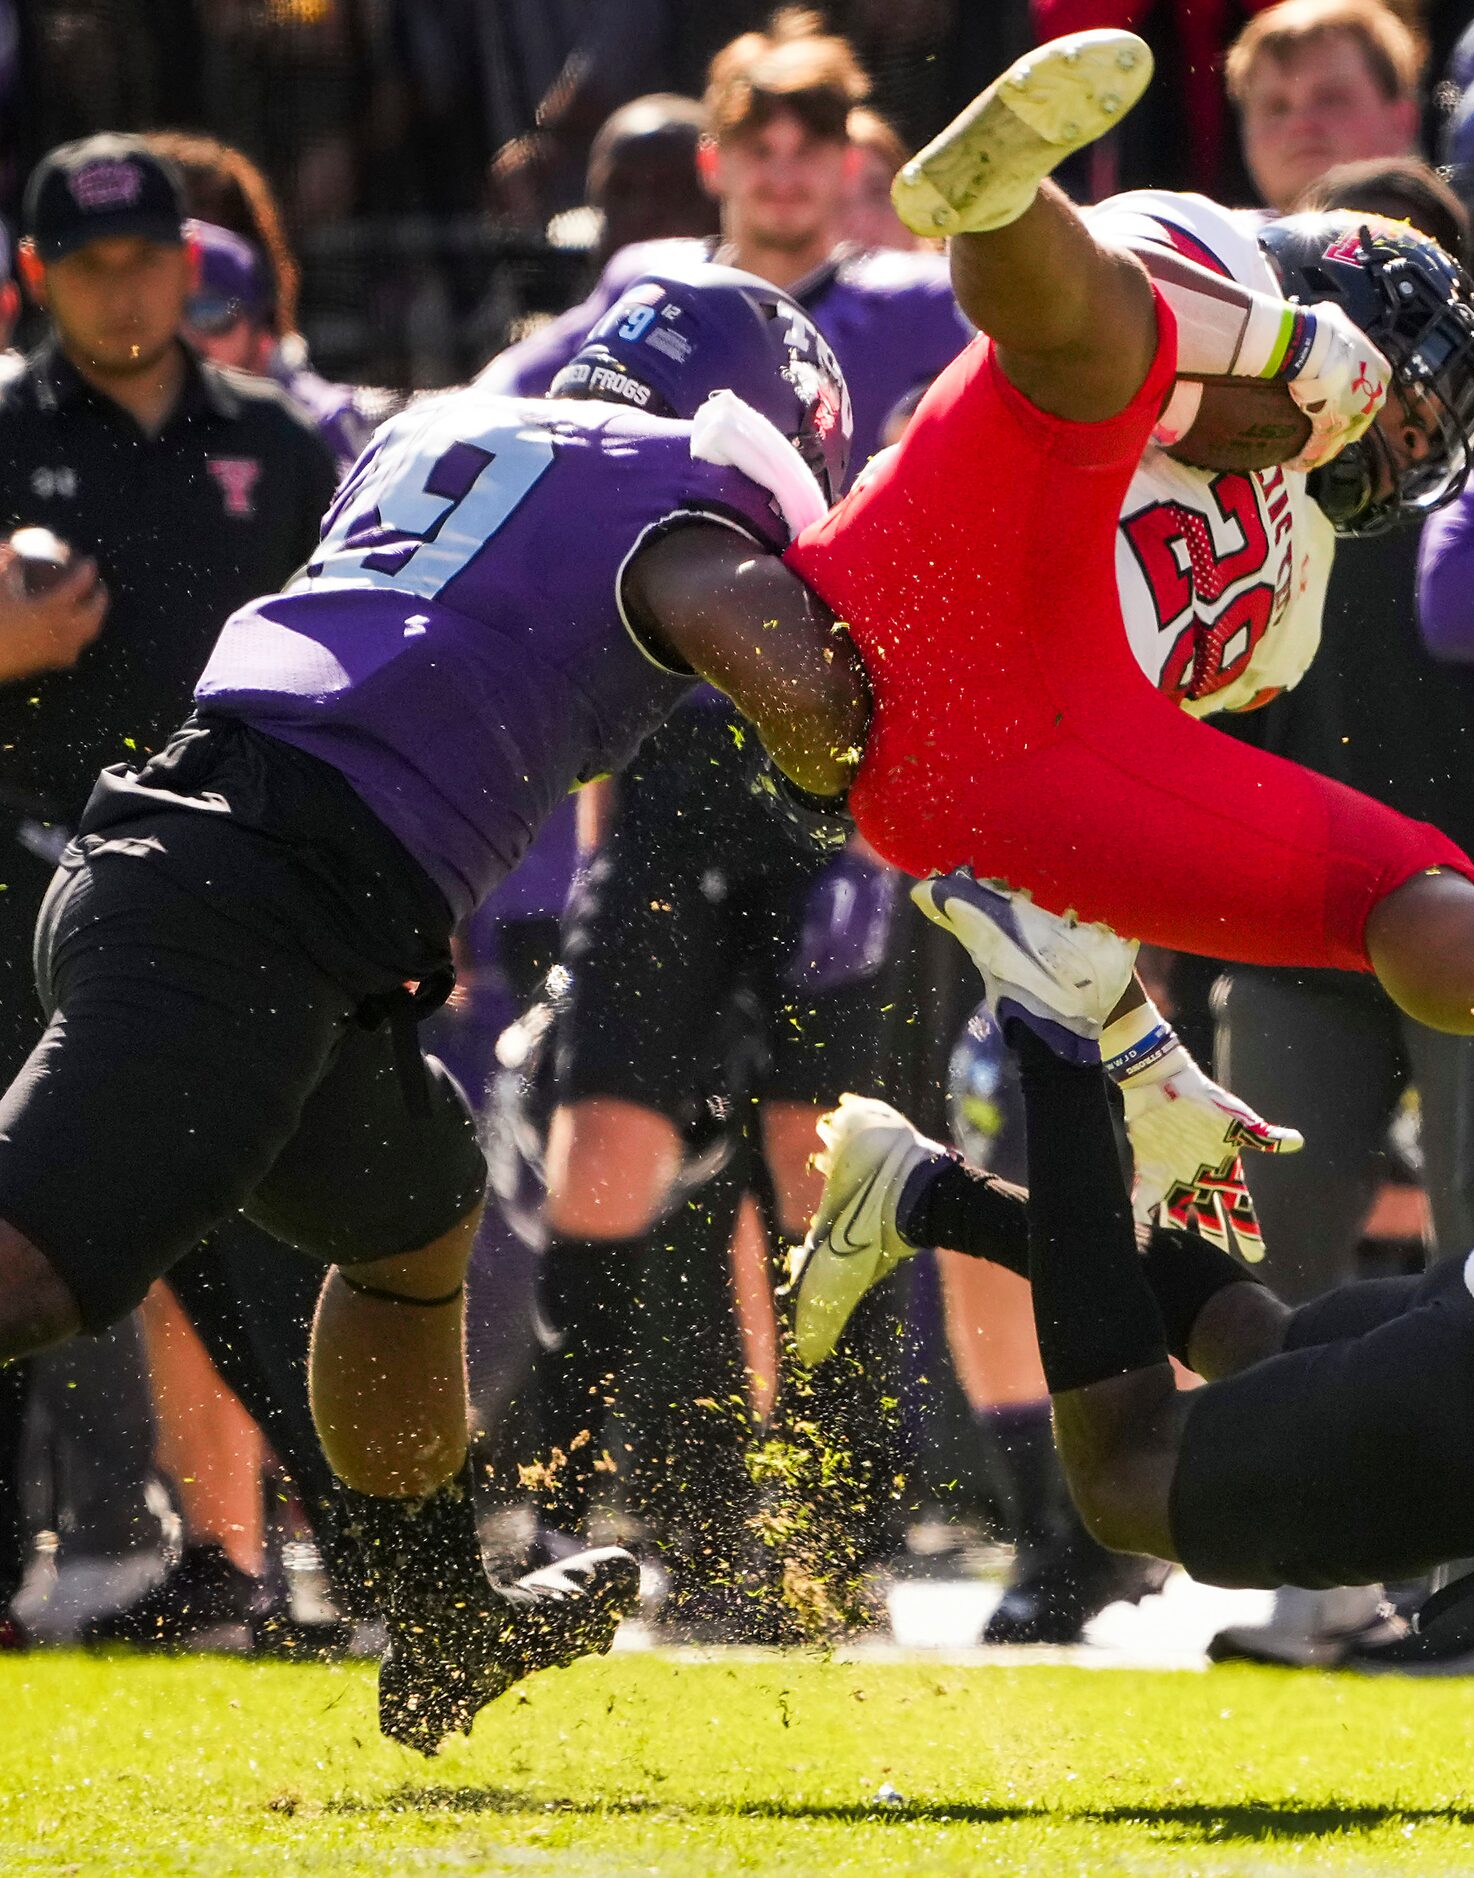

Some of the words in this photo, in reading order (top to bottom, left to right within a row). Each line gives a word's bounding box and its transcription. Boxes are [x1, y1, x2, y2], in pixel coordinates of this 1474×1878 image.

[660, 303, 682, 320] 12
[588, 366, 651, 405] FROGS
[1119, 470, 1275, 702] 28
